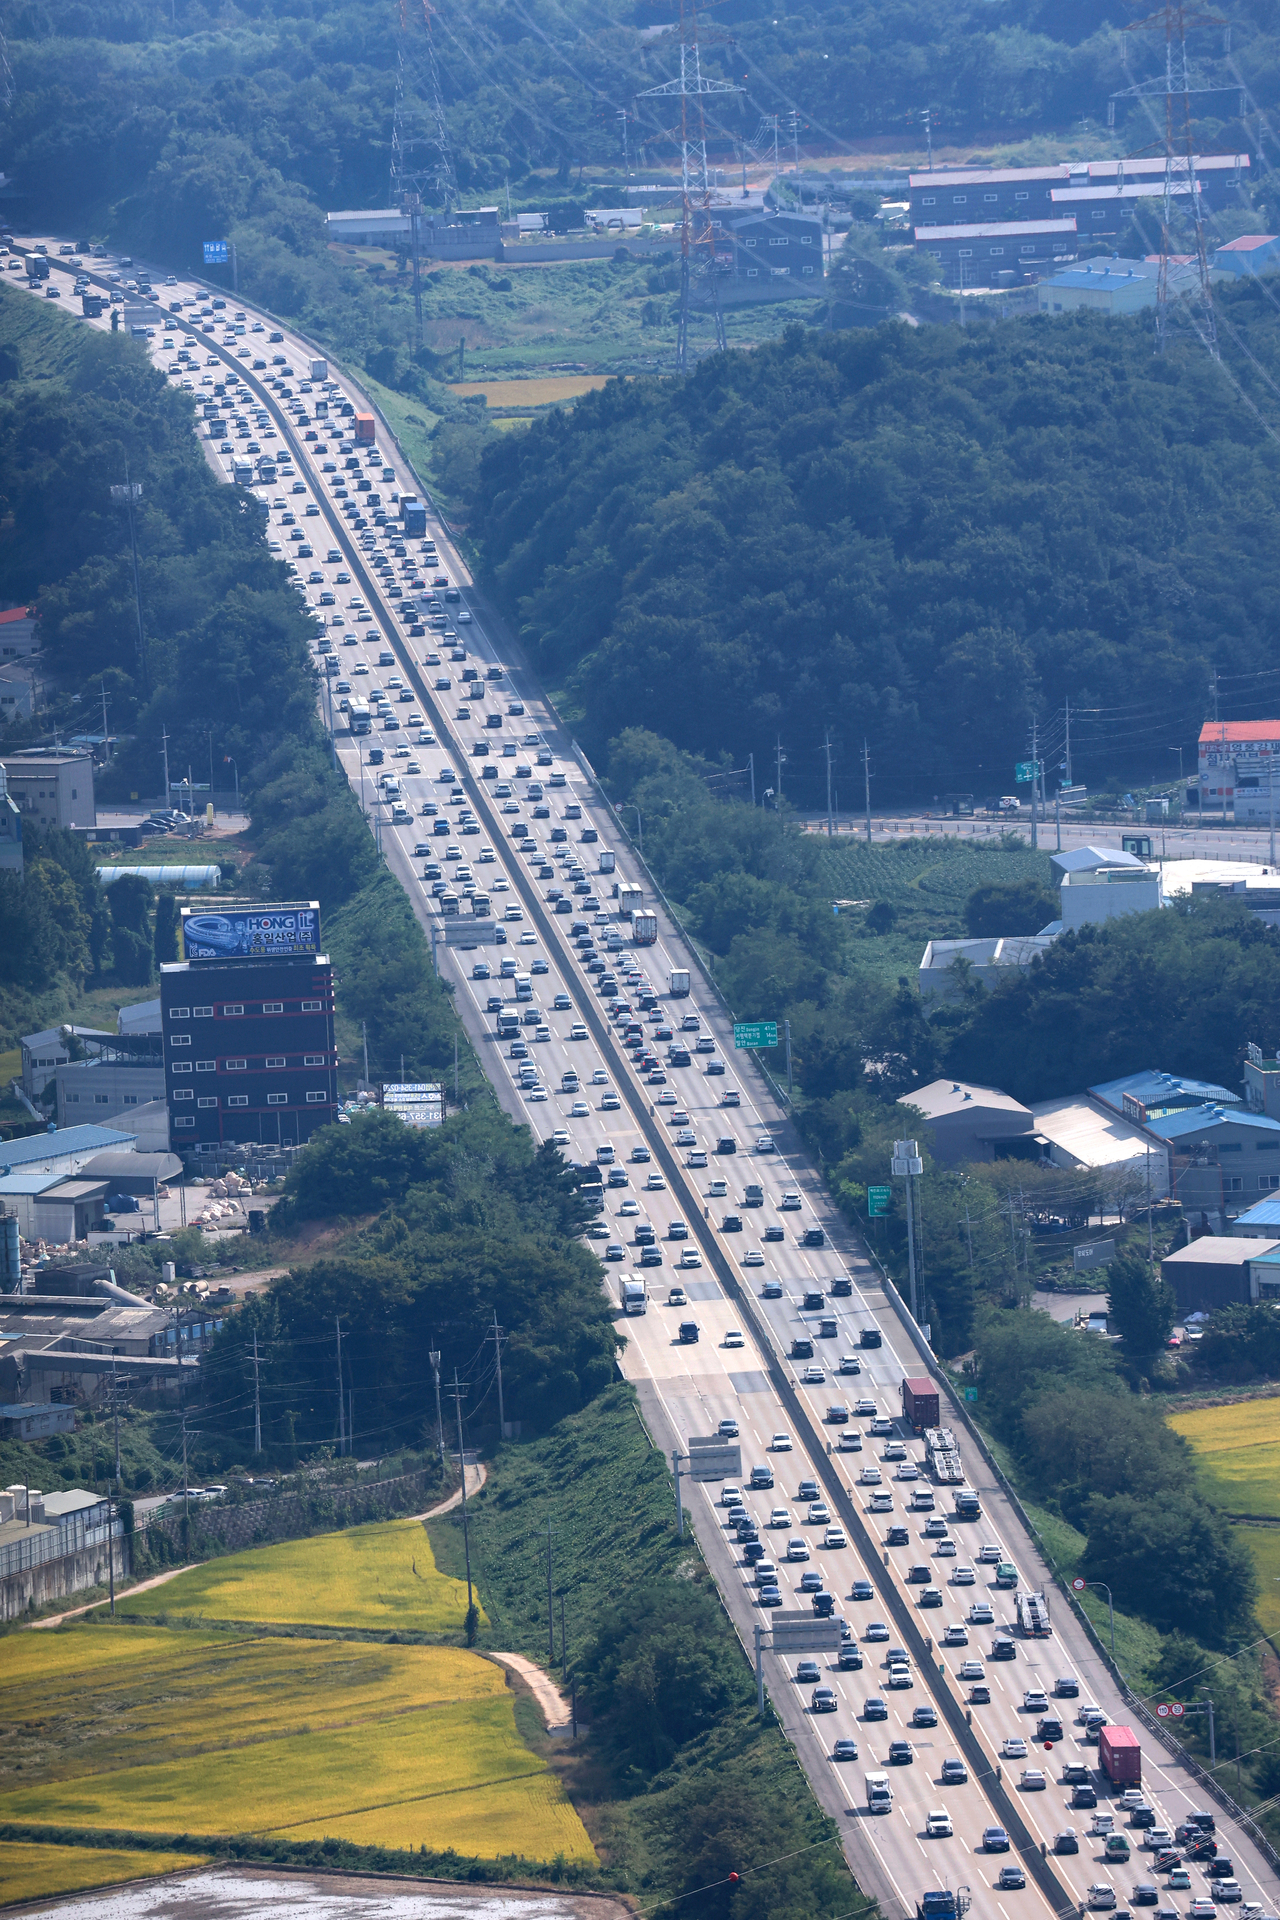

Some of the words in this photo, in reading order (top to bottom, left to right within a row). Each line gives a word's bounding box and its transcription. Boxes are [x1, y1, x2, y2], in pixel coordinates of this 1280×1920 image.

[248, 917, 294, 930] HONG
[252, 931, 297, 944] 홍일산업
[198, 948, 217, 957] FDA
